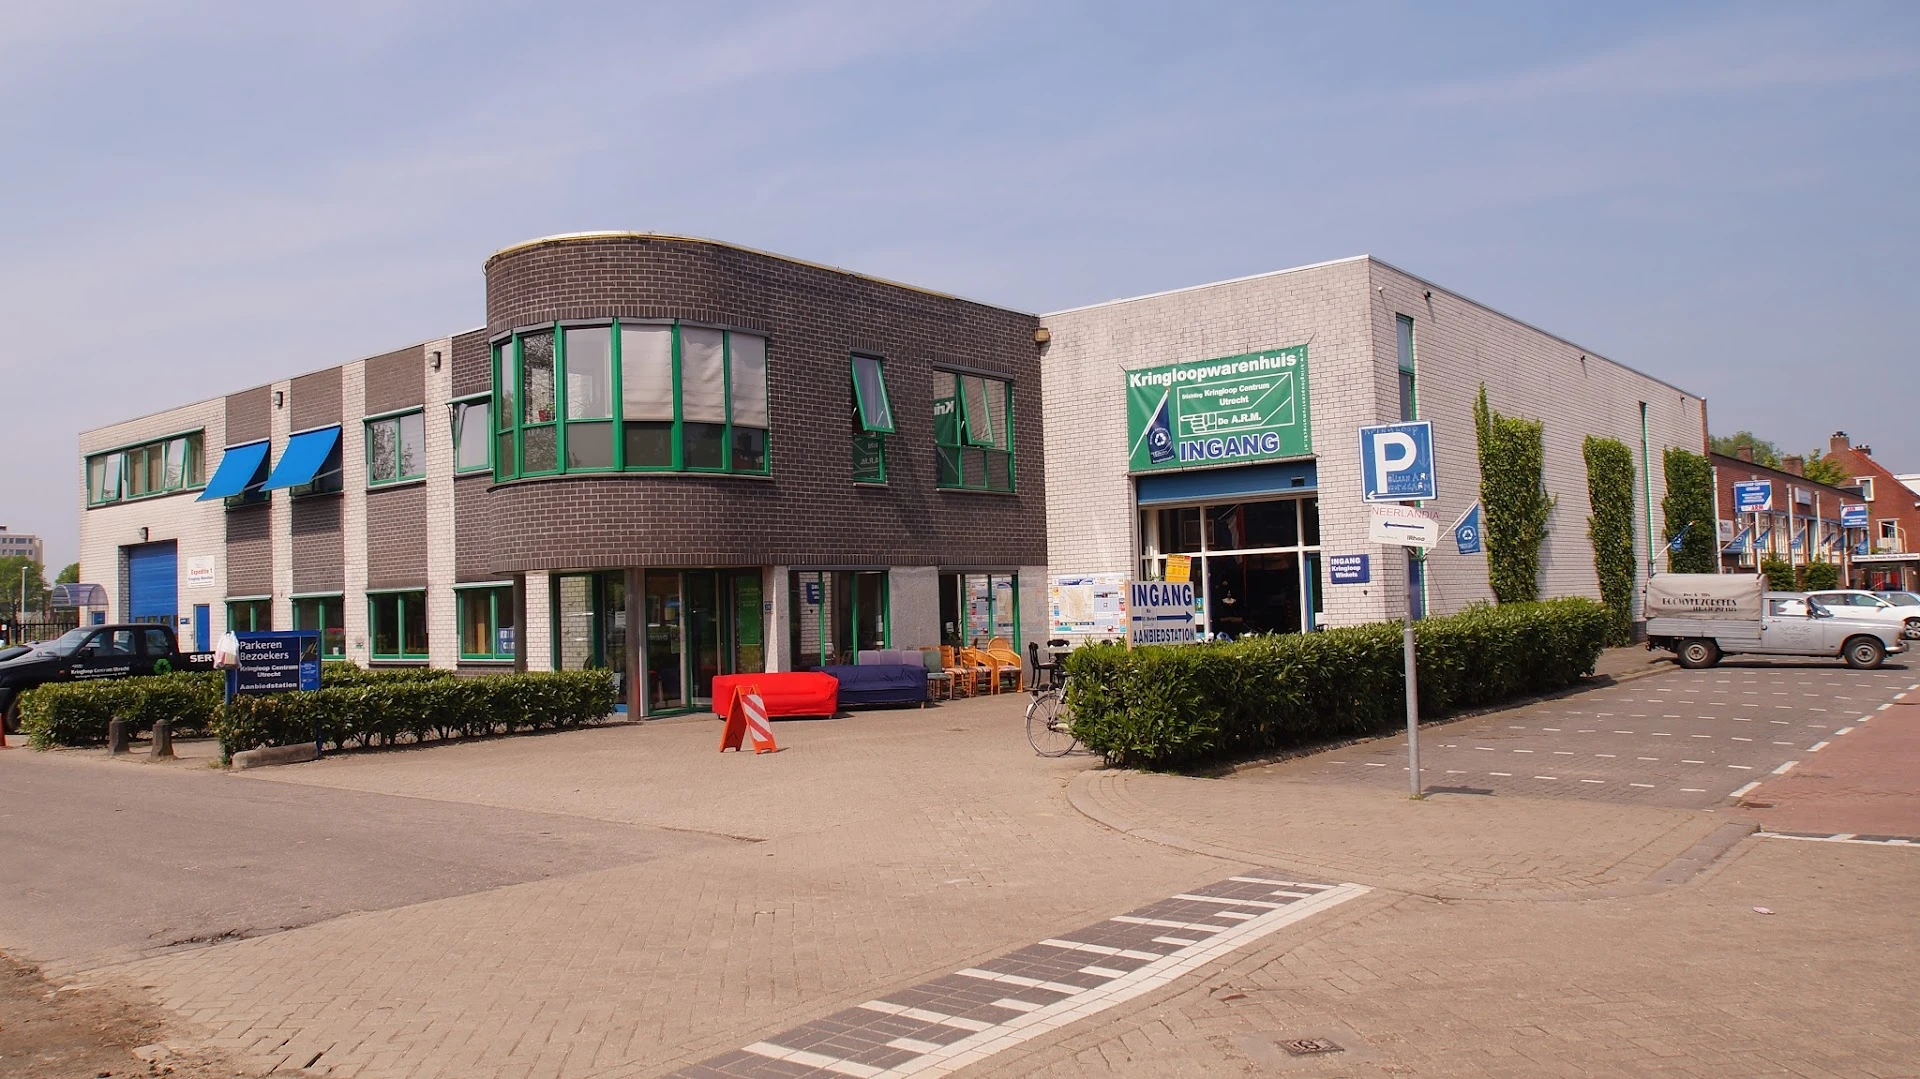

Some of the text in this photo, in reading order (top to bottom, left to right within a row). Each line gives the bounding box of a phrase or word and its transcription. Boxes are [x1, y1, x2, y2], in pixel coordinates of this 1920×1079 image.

[1129, 353, 1297, 388] Kringloopwarenhuis
[1204, 387, 1237, 397] Kringloop
[1239, 383, 1270, 392] Centrum
[1219, 395, 1249, 406] Utrecht
[1231, 412, 1262, 424] A.R.M.
[1178, 432, 1280, 462] INGANG
[1373, 431, 1417, 493] P
[1372, 507, 1439, 519] NEERLANDIA
[1331, 557, 1361, 565] INGANG
[1331, 565, 1361, 573] Kringloop
[1132, 584, 1192, 607] INGANG
[1133, 628, 1195, 643] AANBIEDSTATION
[240, 640, 282, 650] Parkeren
[240, 650, 289, 660] Bezoekers
[240, 665, 270, 673] Kringloop
[240, 682, 297, 690] Aanbiedstation
